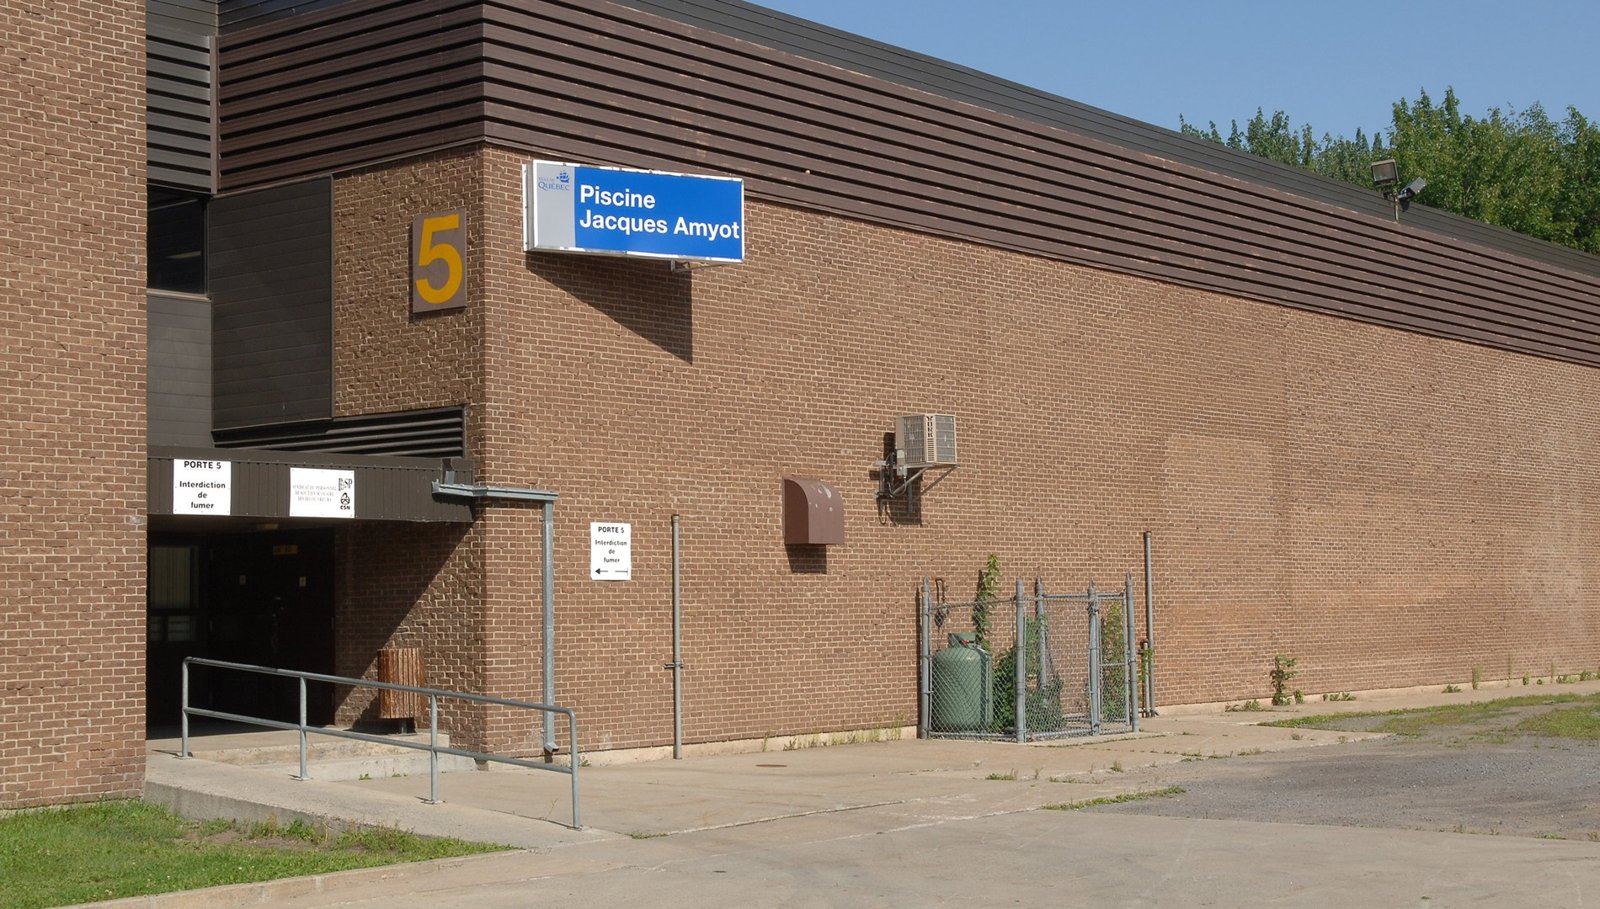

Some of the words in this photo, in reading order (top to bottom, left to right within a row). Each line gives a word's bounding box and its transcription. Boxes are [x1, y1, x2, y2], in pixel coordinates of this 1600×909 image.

[580, 184, 656, 209] Piscine
[579, 209, 668, 235] Jacques
[673, 216, 740, 241] Amyot
[415, 213, 463, 304] 5
[183, 460, 213, 469] PORTE
[216, 461, 222, 469] 5
[179, 480, 226, 489] Interdiction
[197, 491, 208, 499] de
[190, 501, 214, 509] fumer
